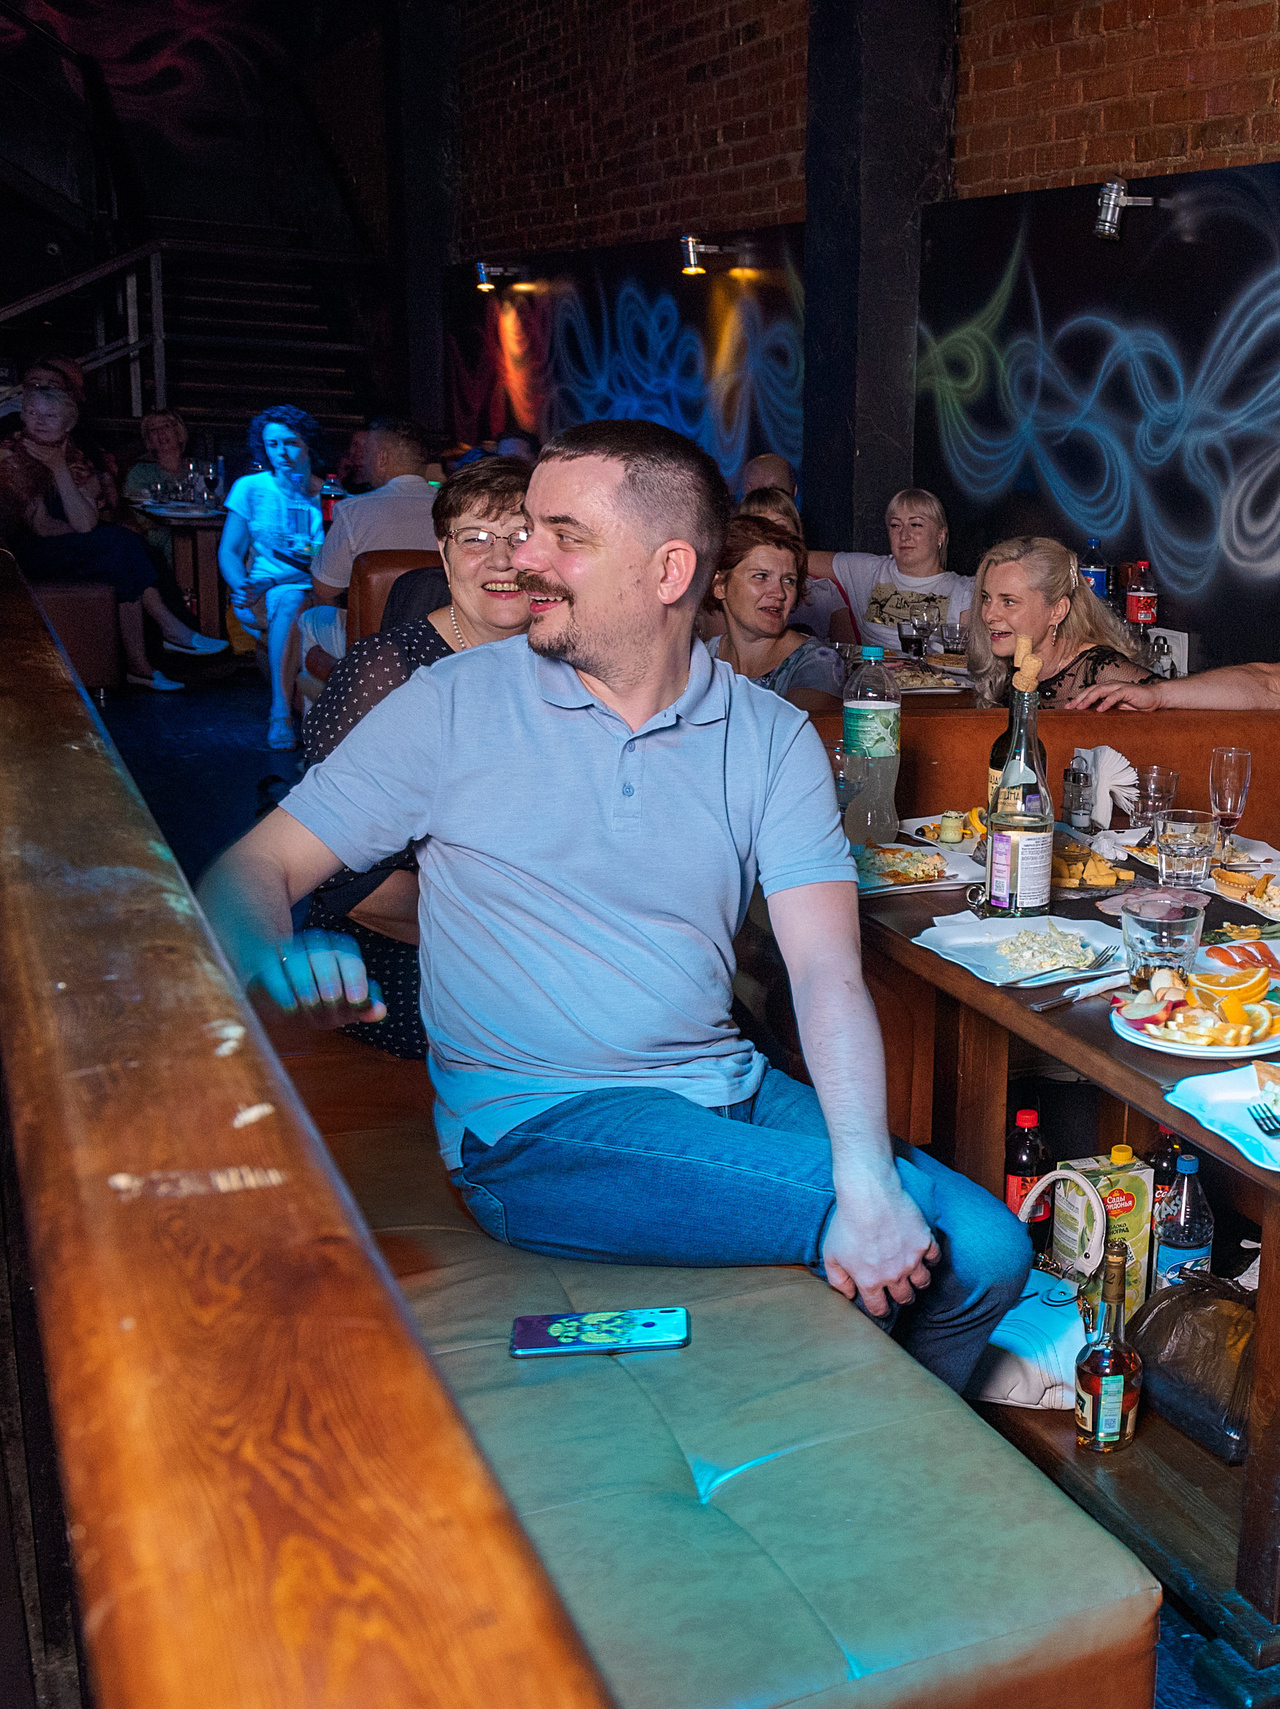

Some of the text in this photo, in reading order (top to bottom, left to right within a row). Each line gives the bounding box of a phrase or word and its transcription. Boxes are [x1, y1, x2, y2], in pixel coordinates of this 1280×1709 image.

[1155, 1189, 1178, 1198] Cola
[1106, 1195, 1126, 1204] Сады
[1105, 1200, 1133, 1211] ридонья
